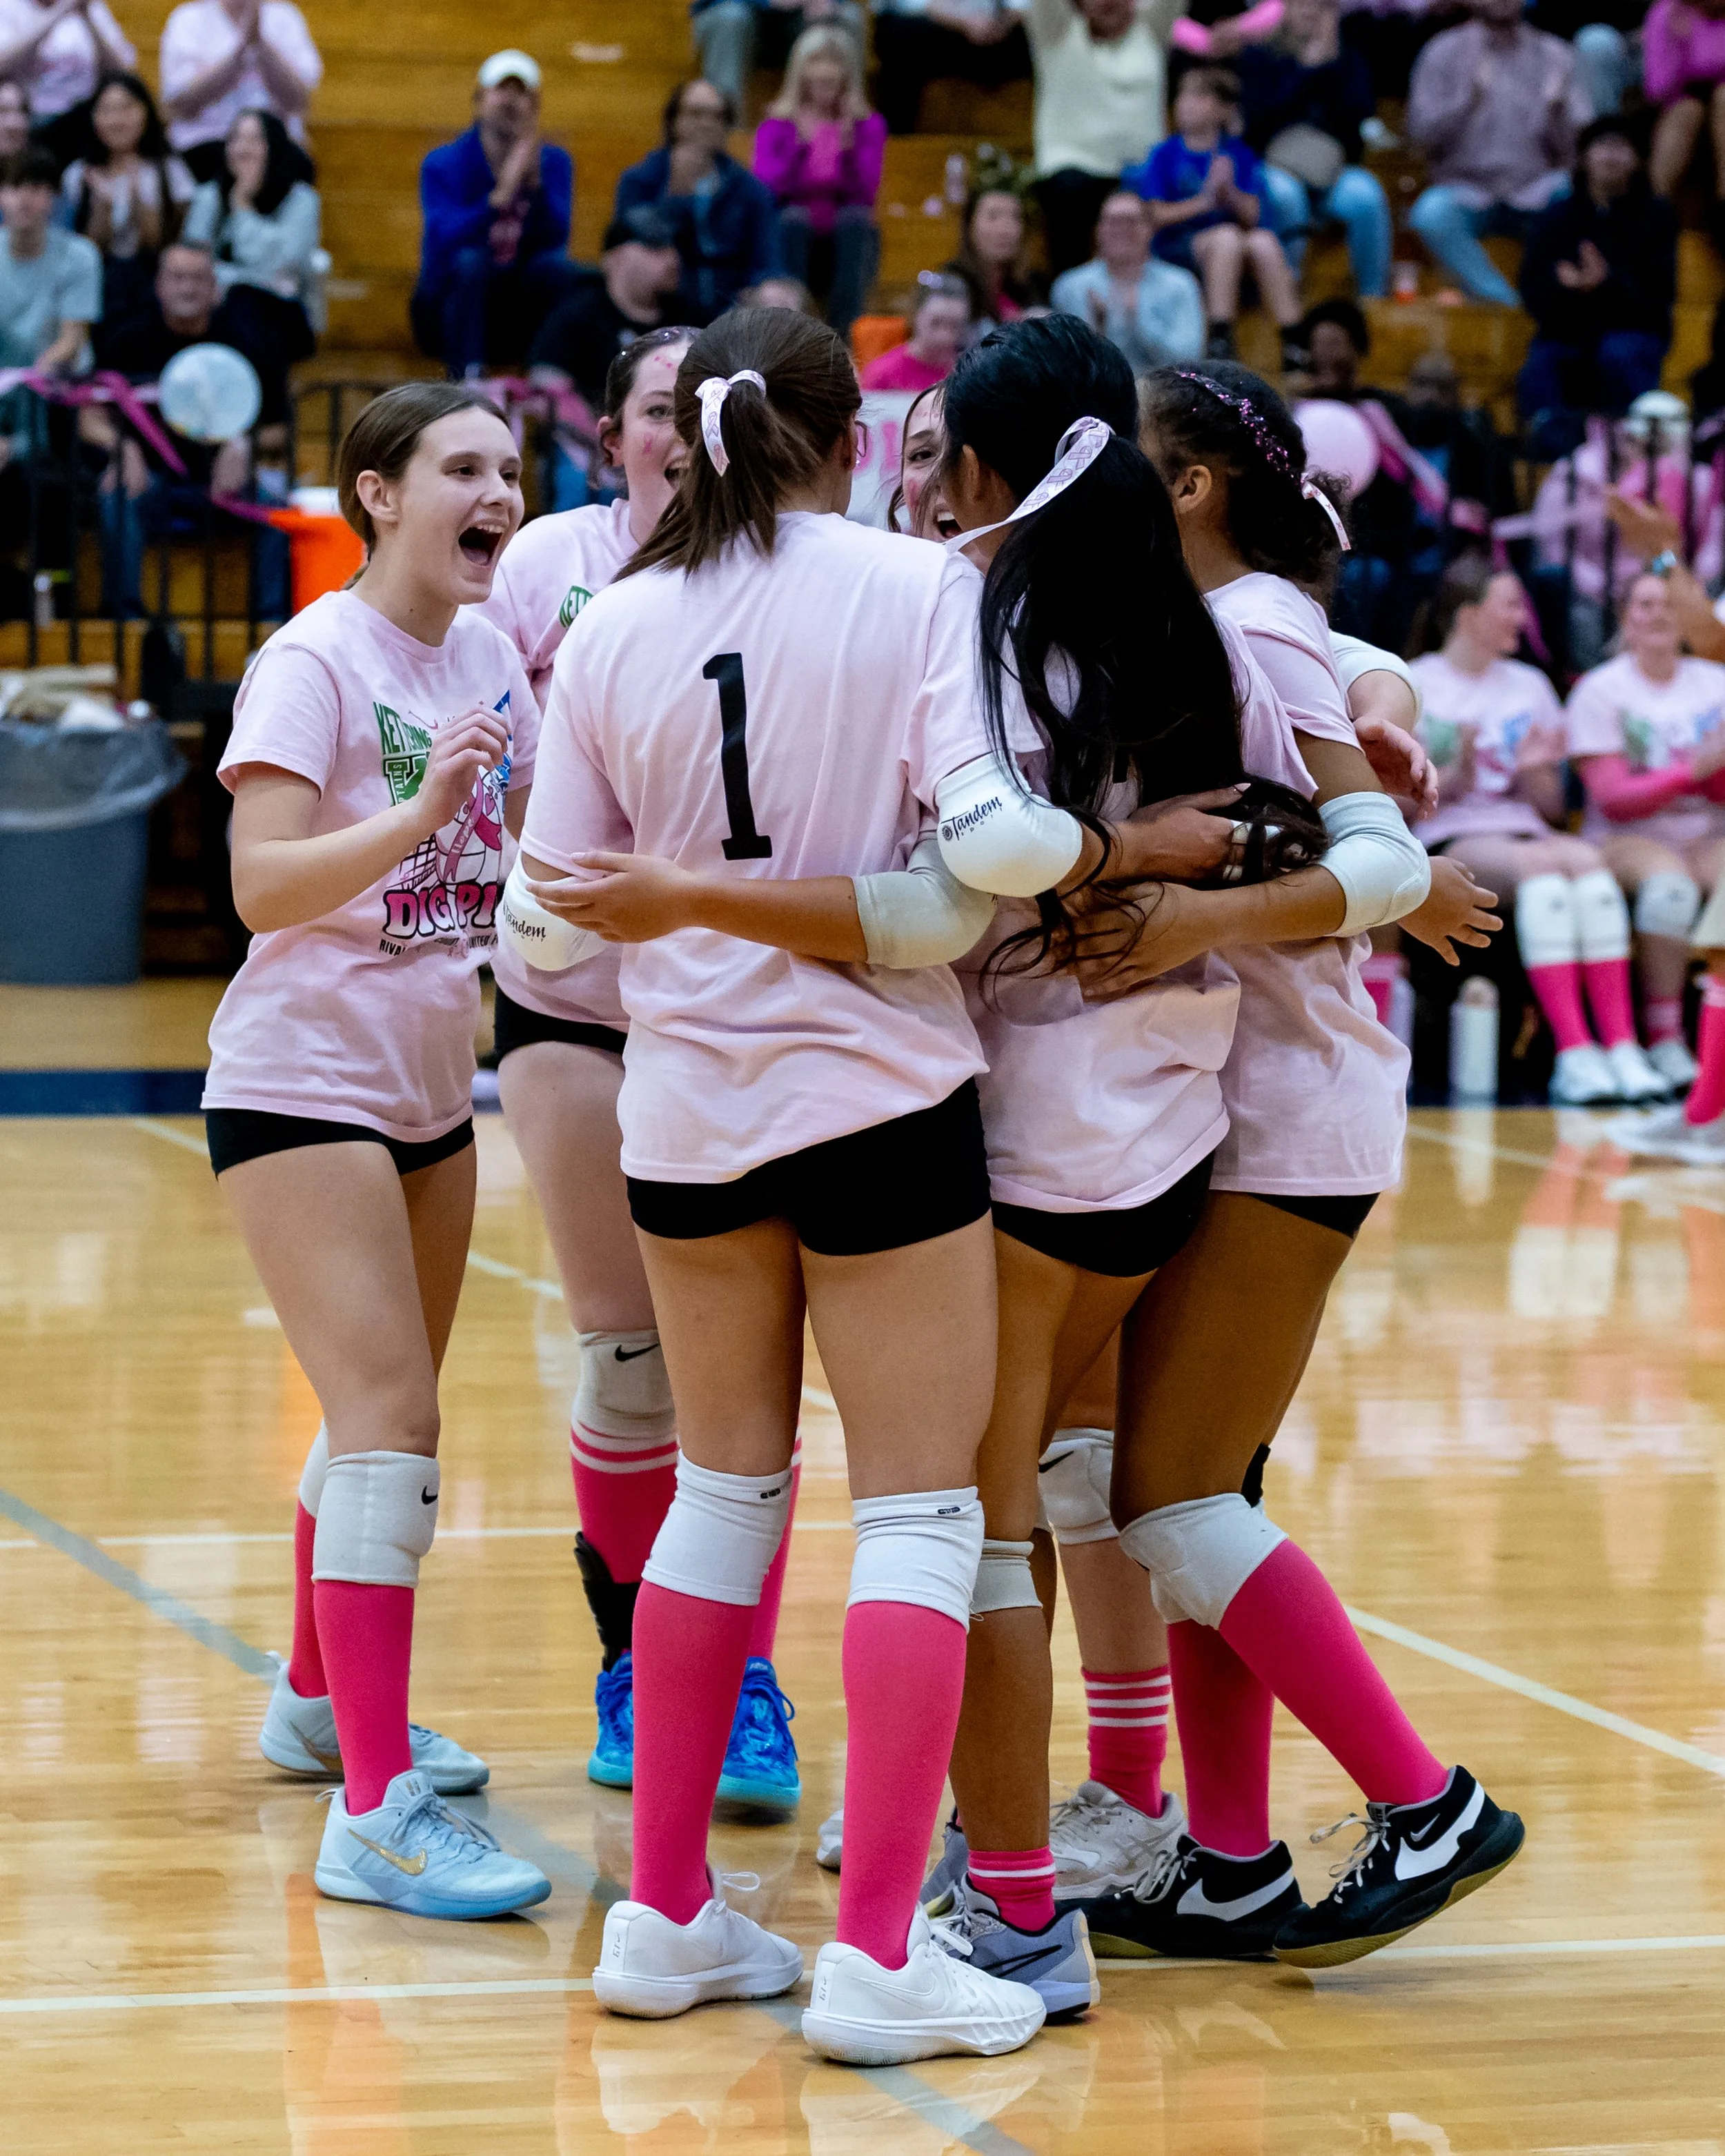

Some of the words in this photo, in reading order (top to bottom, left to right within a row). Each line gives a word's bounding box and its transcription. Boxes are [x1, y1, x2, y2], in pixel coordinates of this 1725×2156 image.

[702, 652, 773, 860] 1
[940, 796, 1003, 841] Tandem
[383, 882, 455, 940] DIG
[453, 881, 504, 929] PI
[505, 904, 546, 938] Tandem
